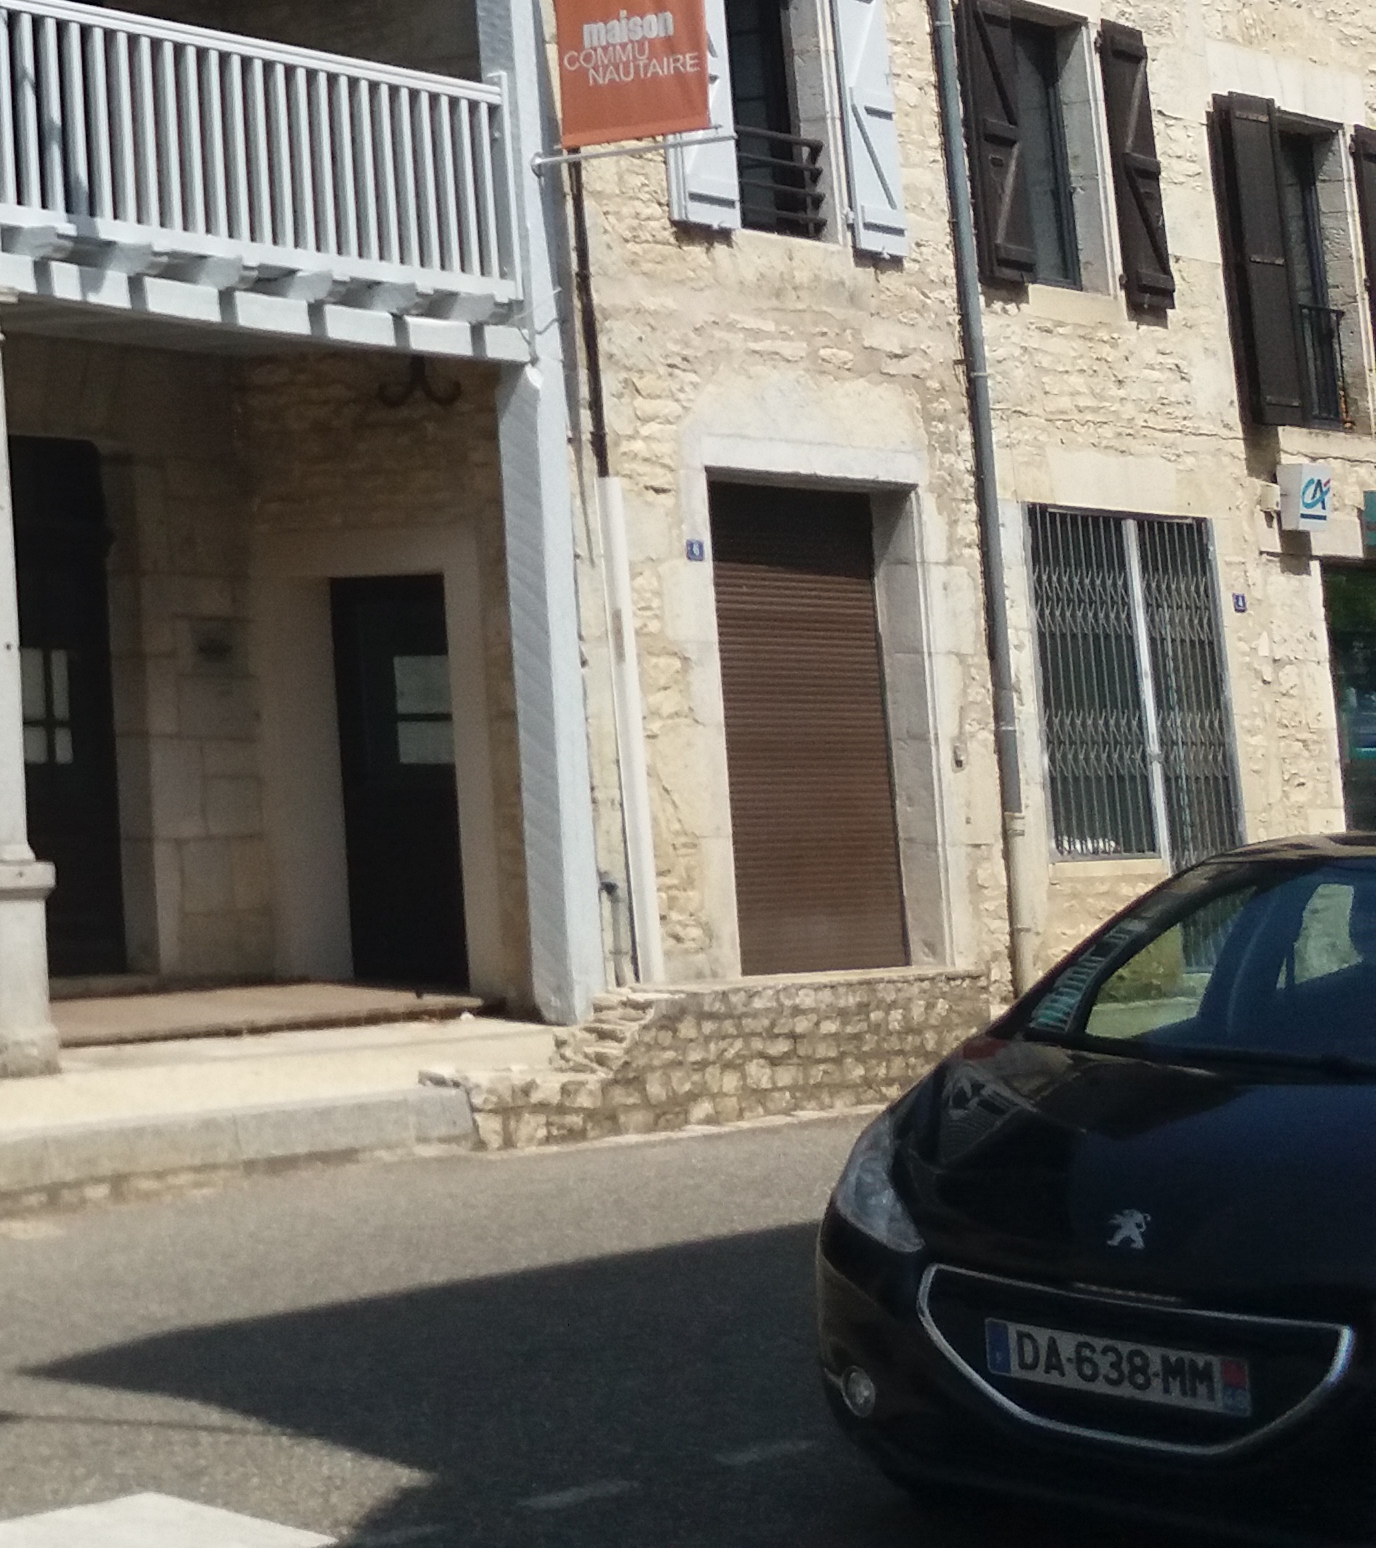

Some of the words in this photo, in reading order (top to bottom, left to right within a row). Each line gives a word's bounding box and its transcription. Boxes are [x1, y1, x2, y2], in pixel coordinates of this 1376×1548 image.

[583, 9, 674, 49] maison
[563, 41, 649, 71] COMMU
[588, 52, 701, 86] NAUTAIRE
[1016, 1329, 1215, 1401] DA-638-MM
